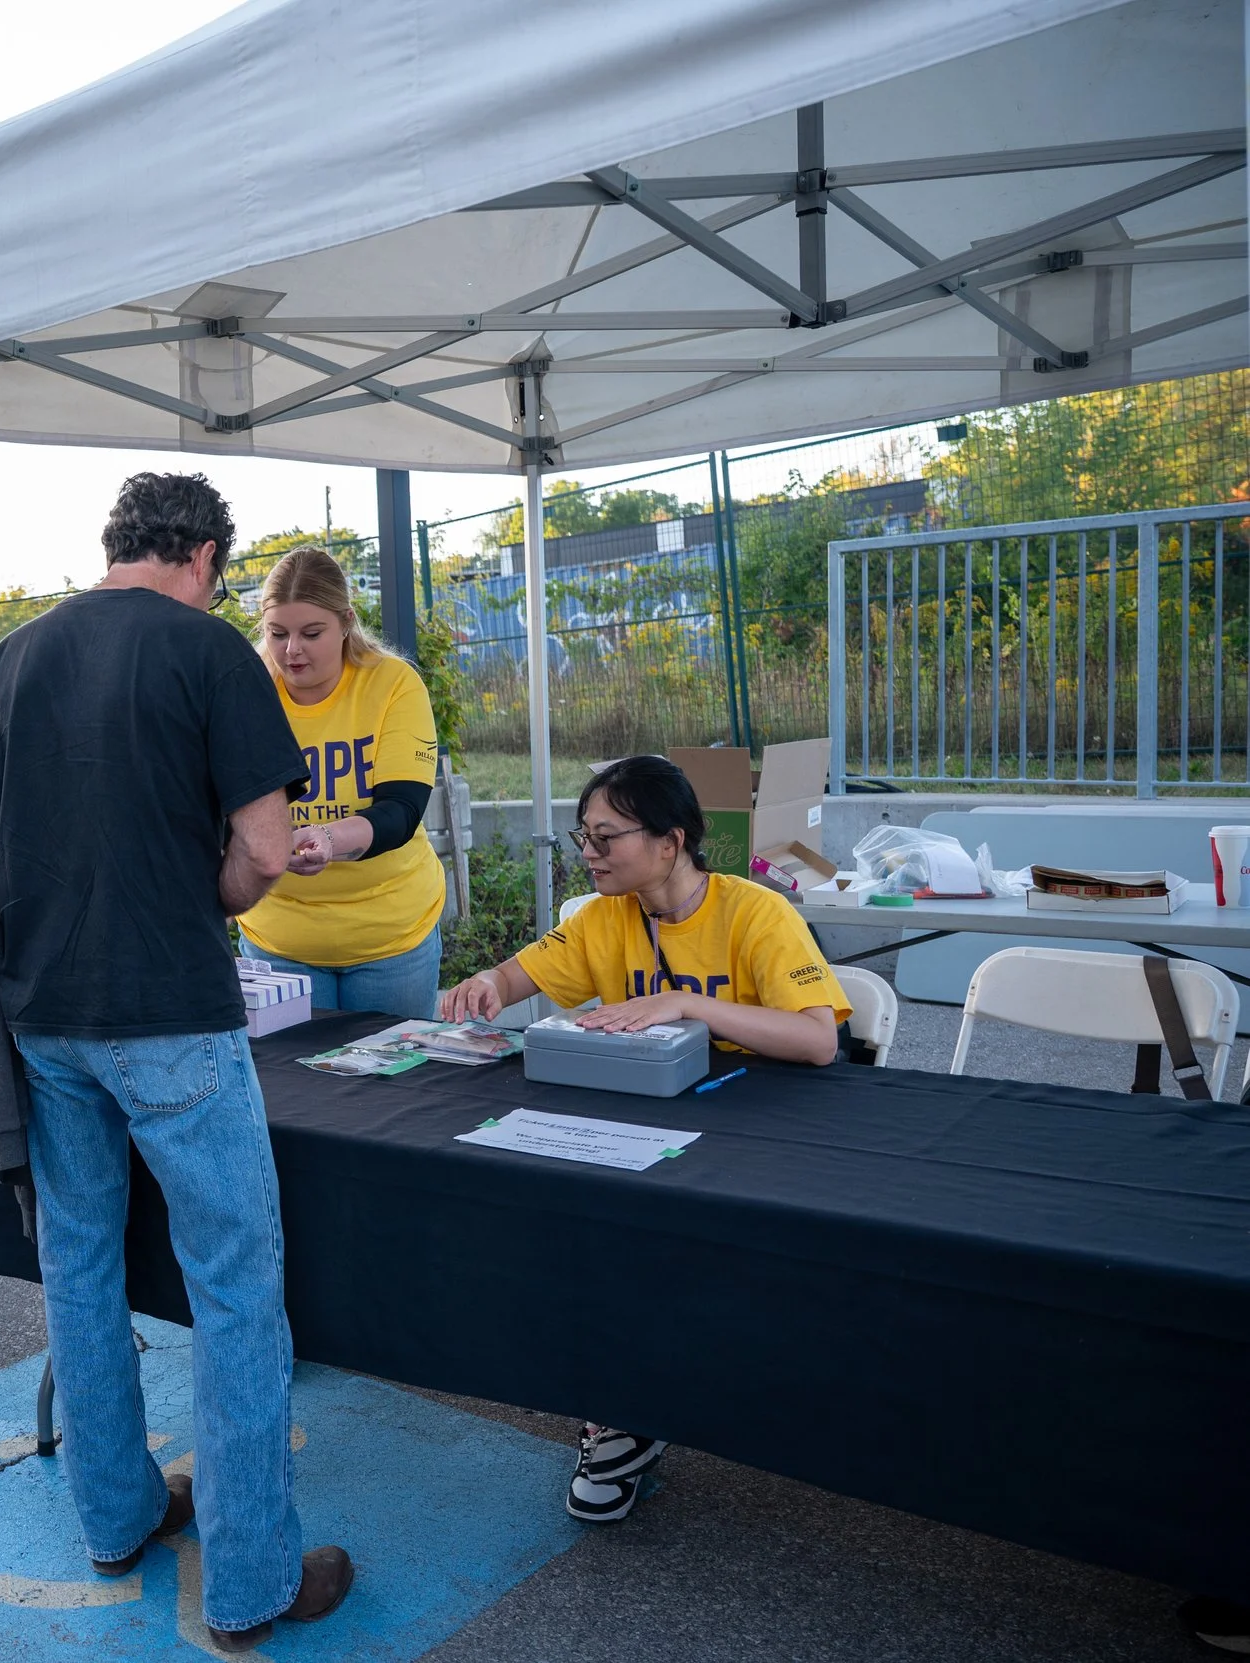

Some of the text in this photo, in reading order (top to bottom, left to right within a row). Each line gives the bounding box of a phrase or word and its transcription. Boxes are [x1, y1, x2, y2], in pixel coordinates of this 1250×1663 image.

[415, 751, 436, 763] DILLO
[296, 734, 374, 803] OPE
[291, 805, 349, 821] IN THE
[518, 1118, 549, 1126] Ticket
[534, 1137, 591, 1147] appreciate
